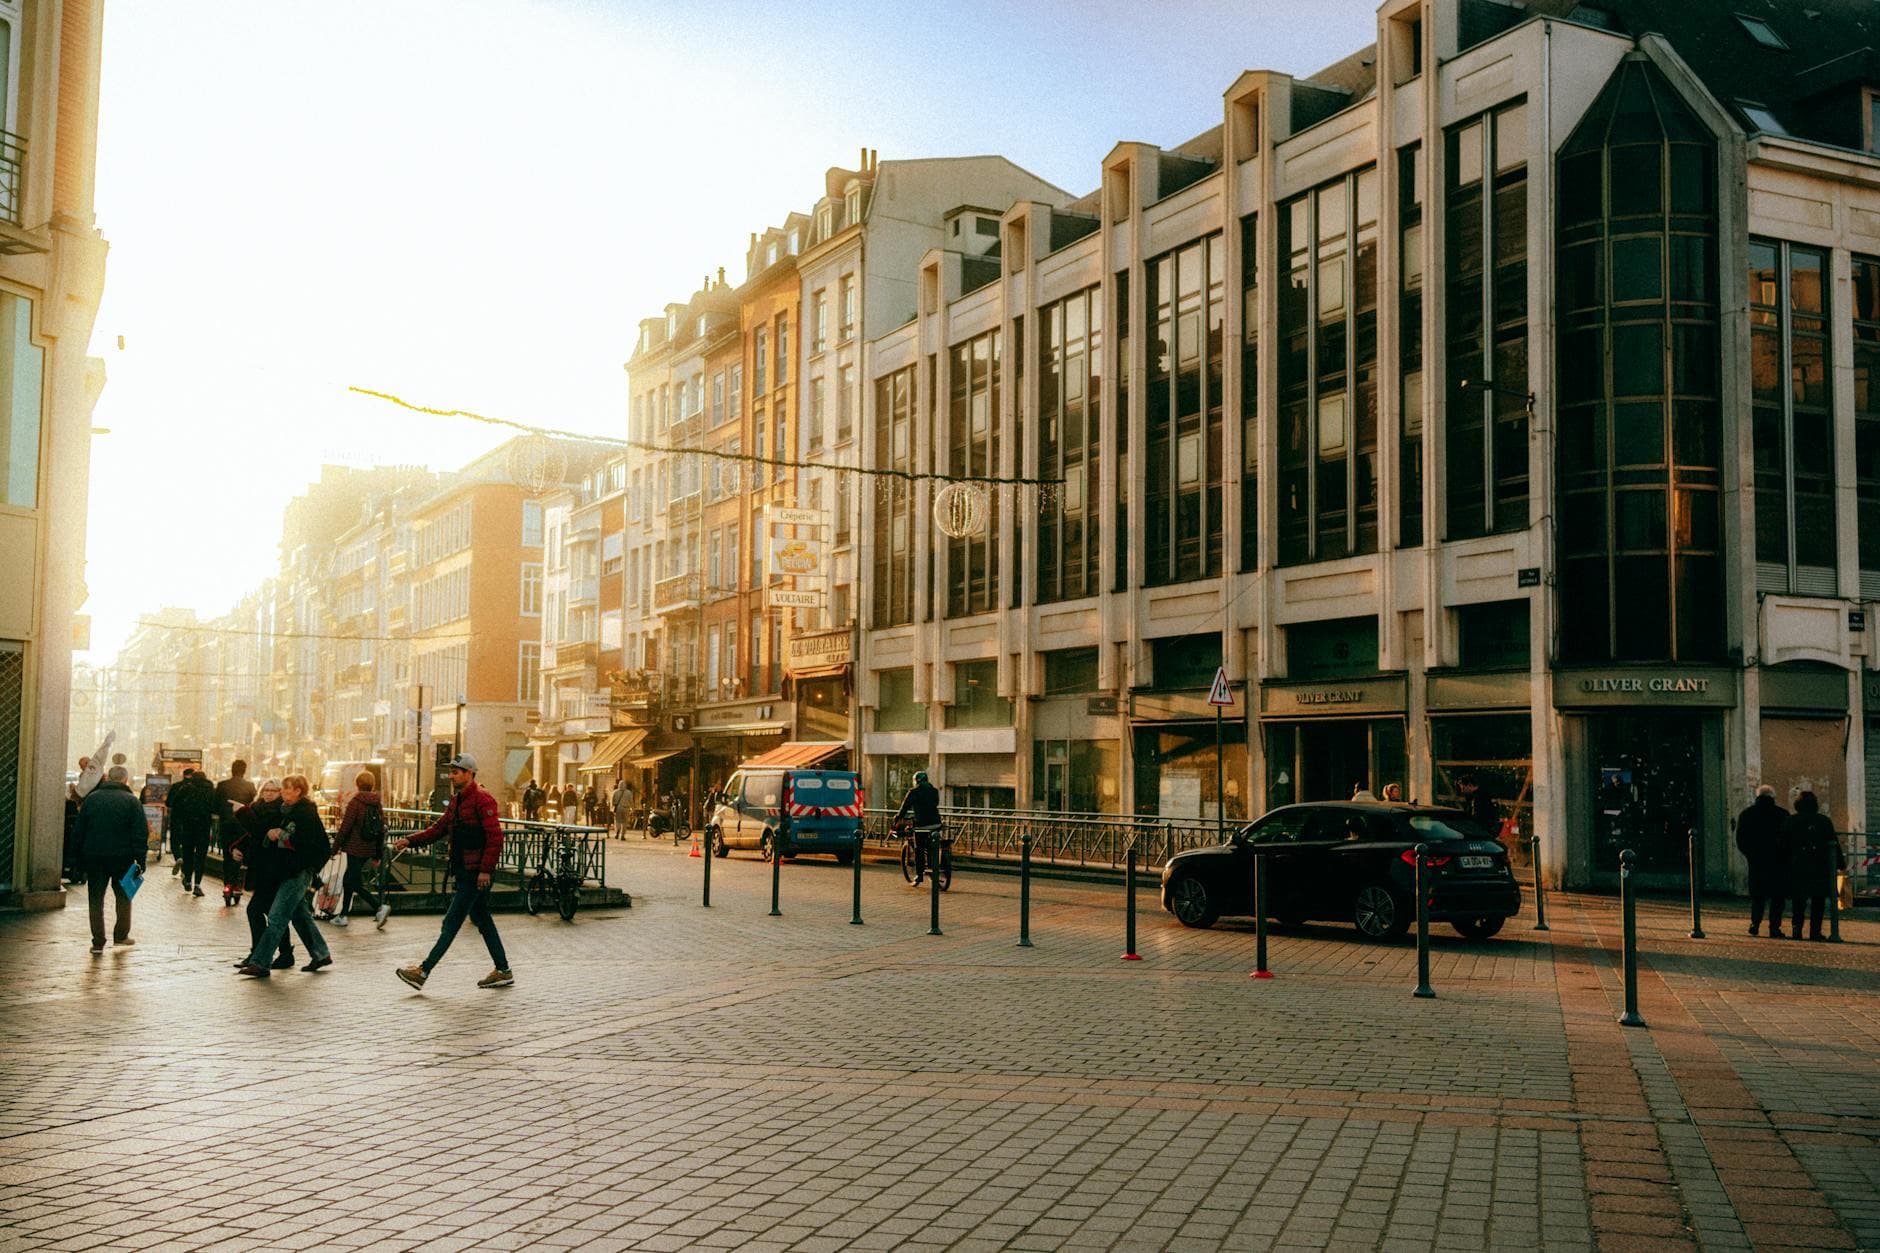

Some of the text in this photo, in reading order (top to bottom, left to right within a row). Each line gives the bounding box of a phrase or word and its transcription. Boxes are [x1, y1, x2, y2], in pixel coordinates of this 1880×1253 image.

[775, 593, 816, 605] VOLTAIRE
[1582, 678, 1709, 692] OLIVER GRANT
[1296, 689, 1361, 704] OLIVER GRANT
